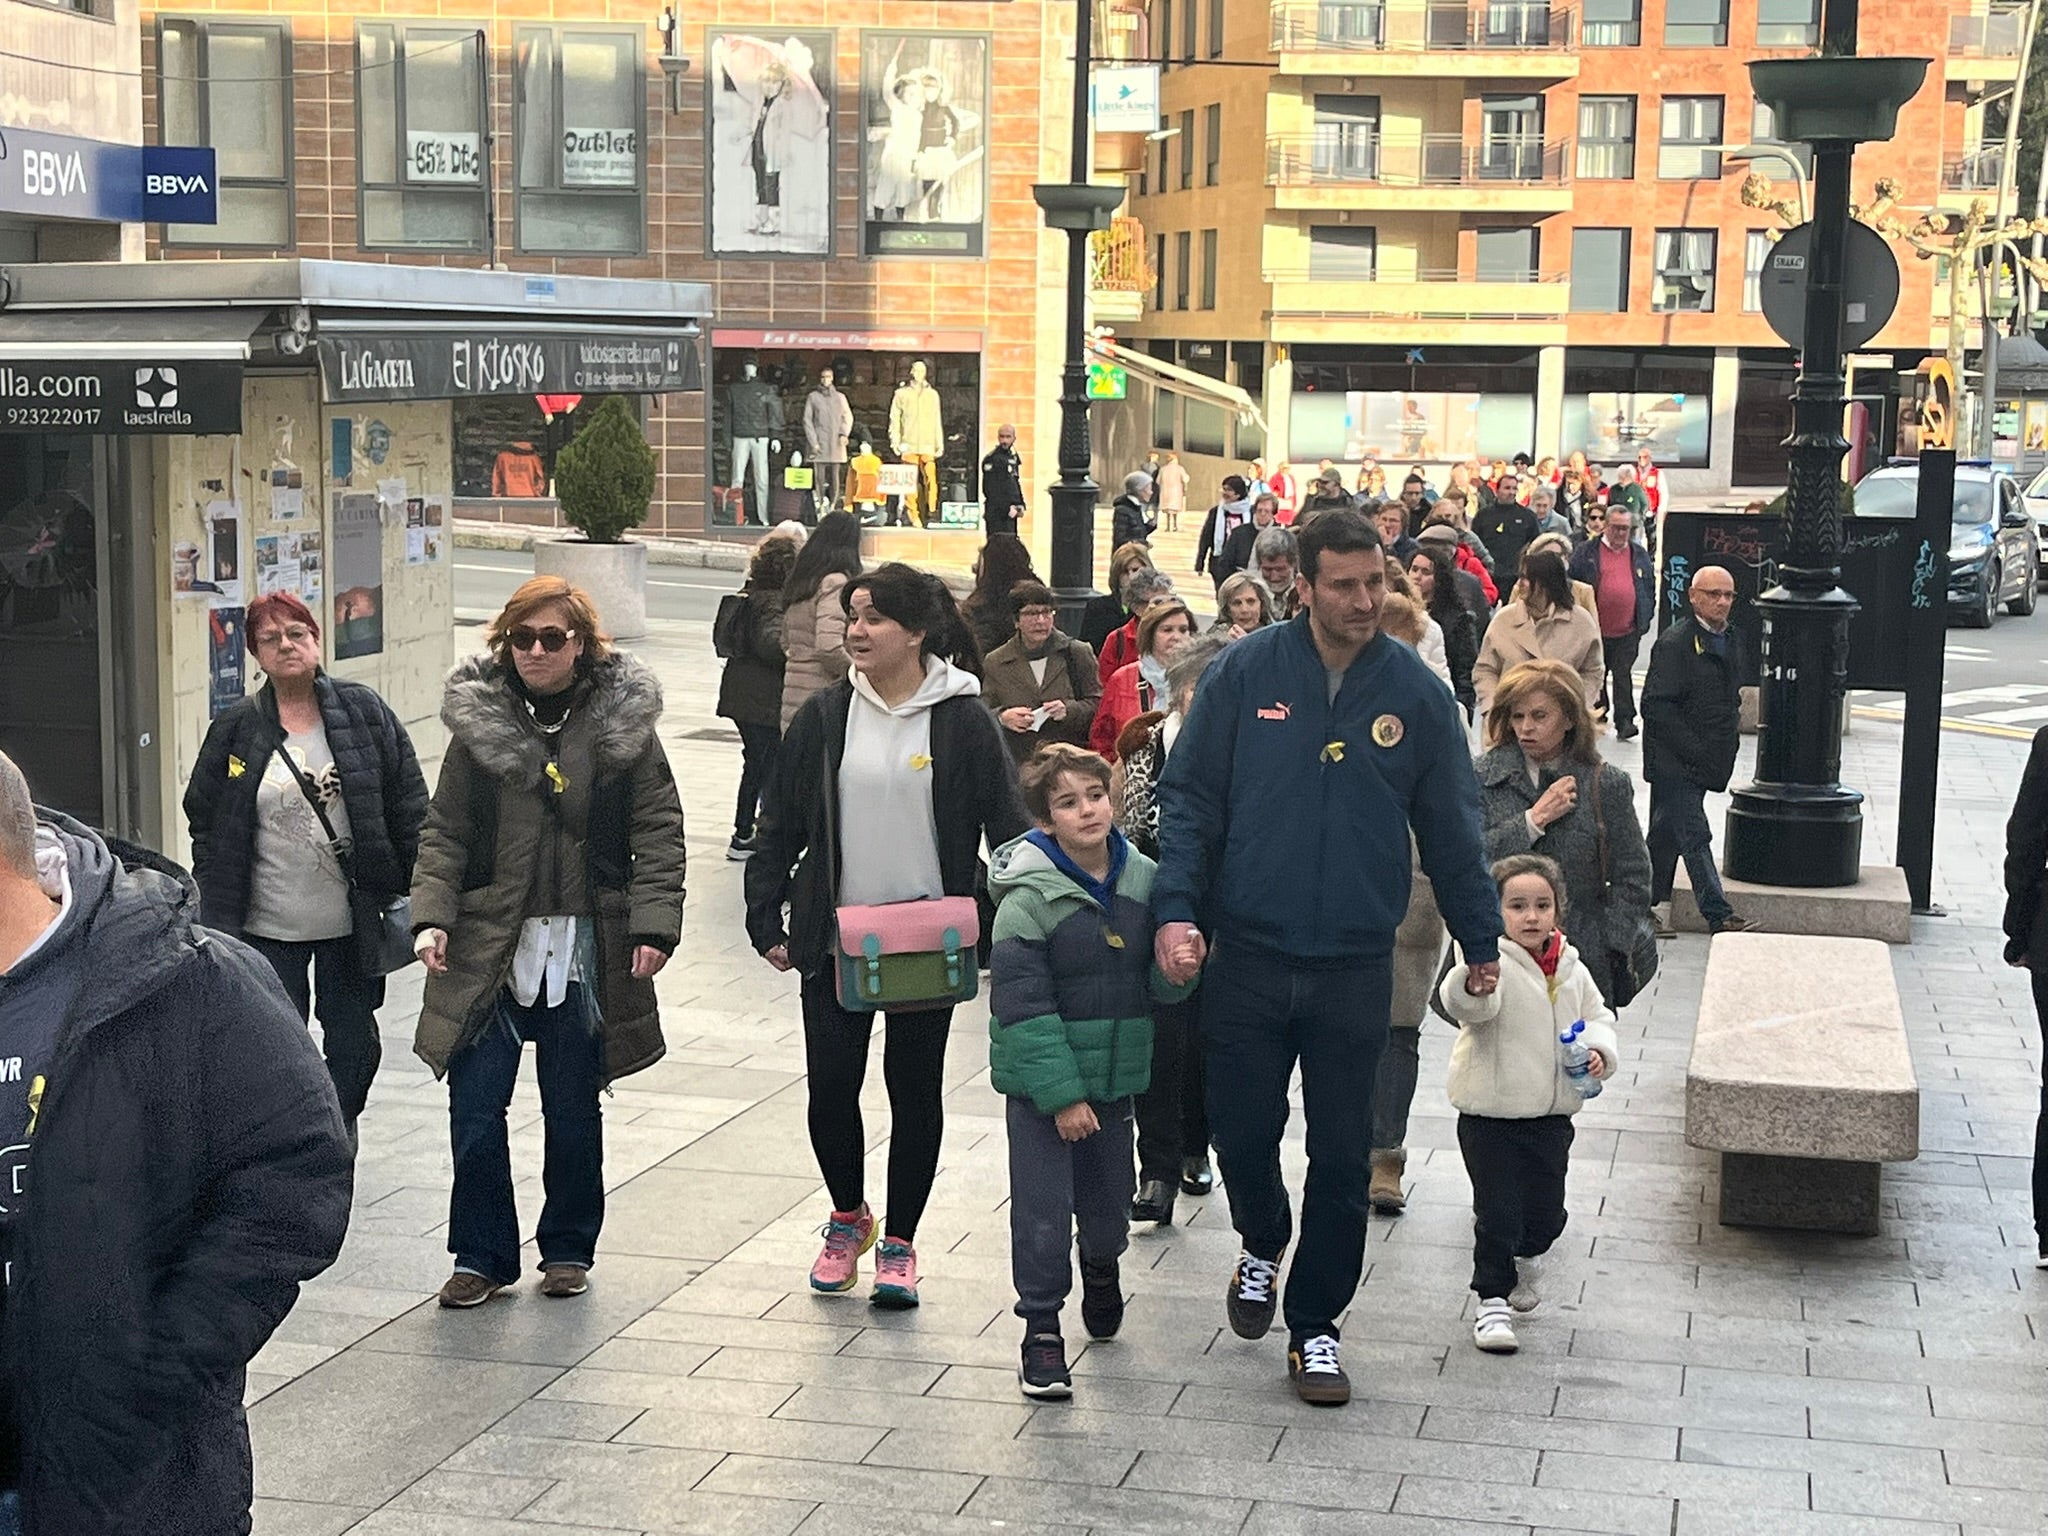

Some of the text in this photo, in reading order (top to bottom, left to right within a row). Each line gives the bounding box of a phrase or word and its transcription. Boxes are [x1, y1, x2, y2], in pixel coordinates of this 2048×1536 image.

[564, 131, 636, 153] Outlet
[23, 149, 87, 197] BBVA
[147, 175, 209, 195] BBVA
[763, 332, 785, 345] En
[788, 333, 842, 345] Forma
[8, 408, 101, 425] 923222017
[124, 409, 192, 425] laestrella
